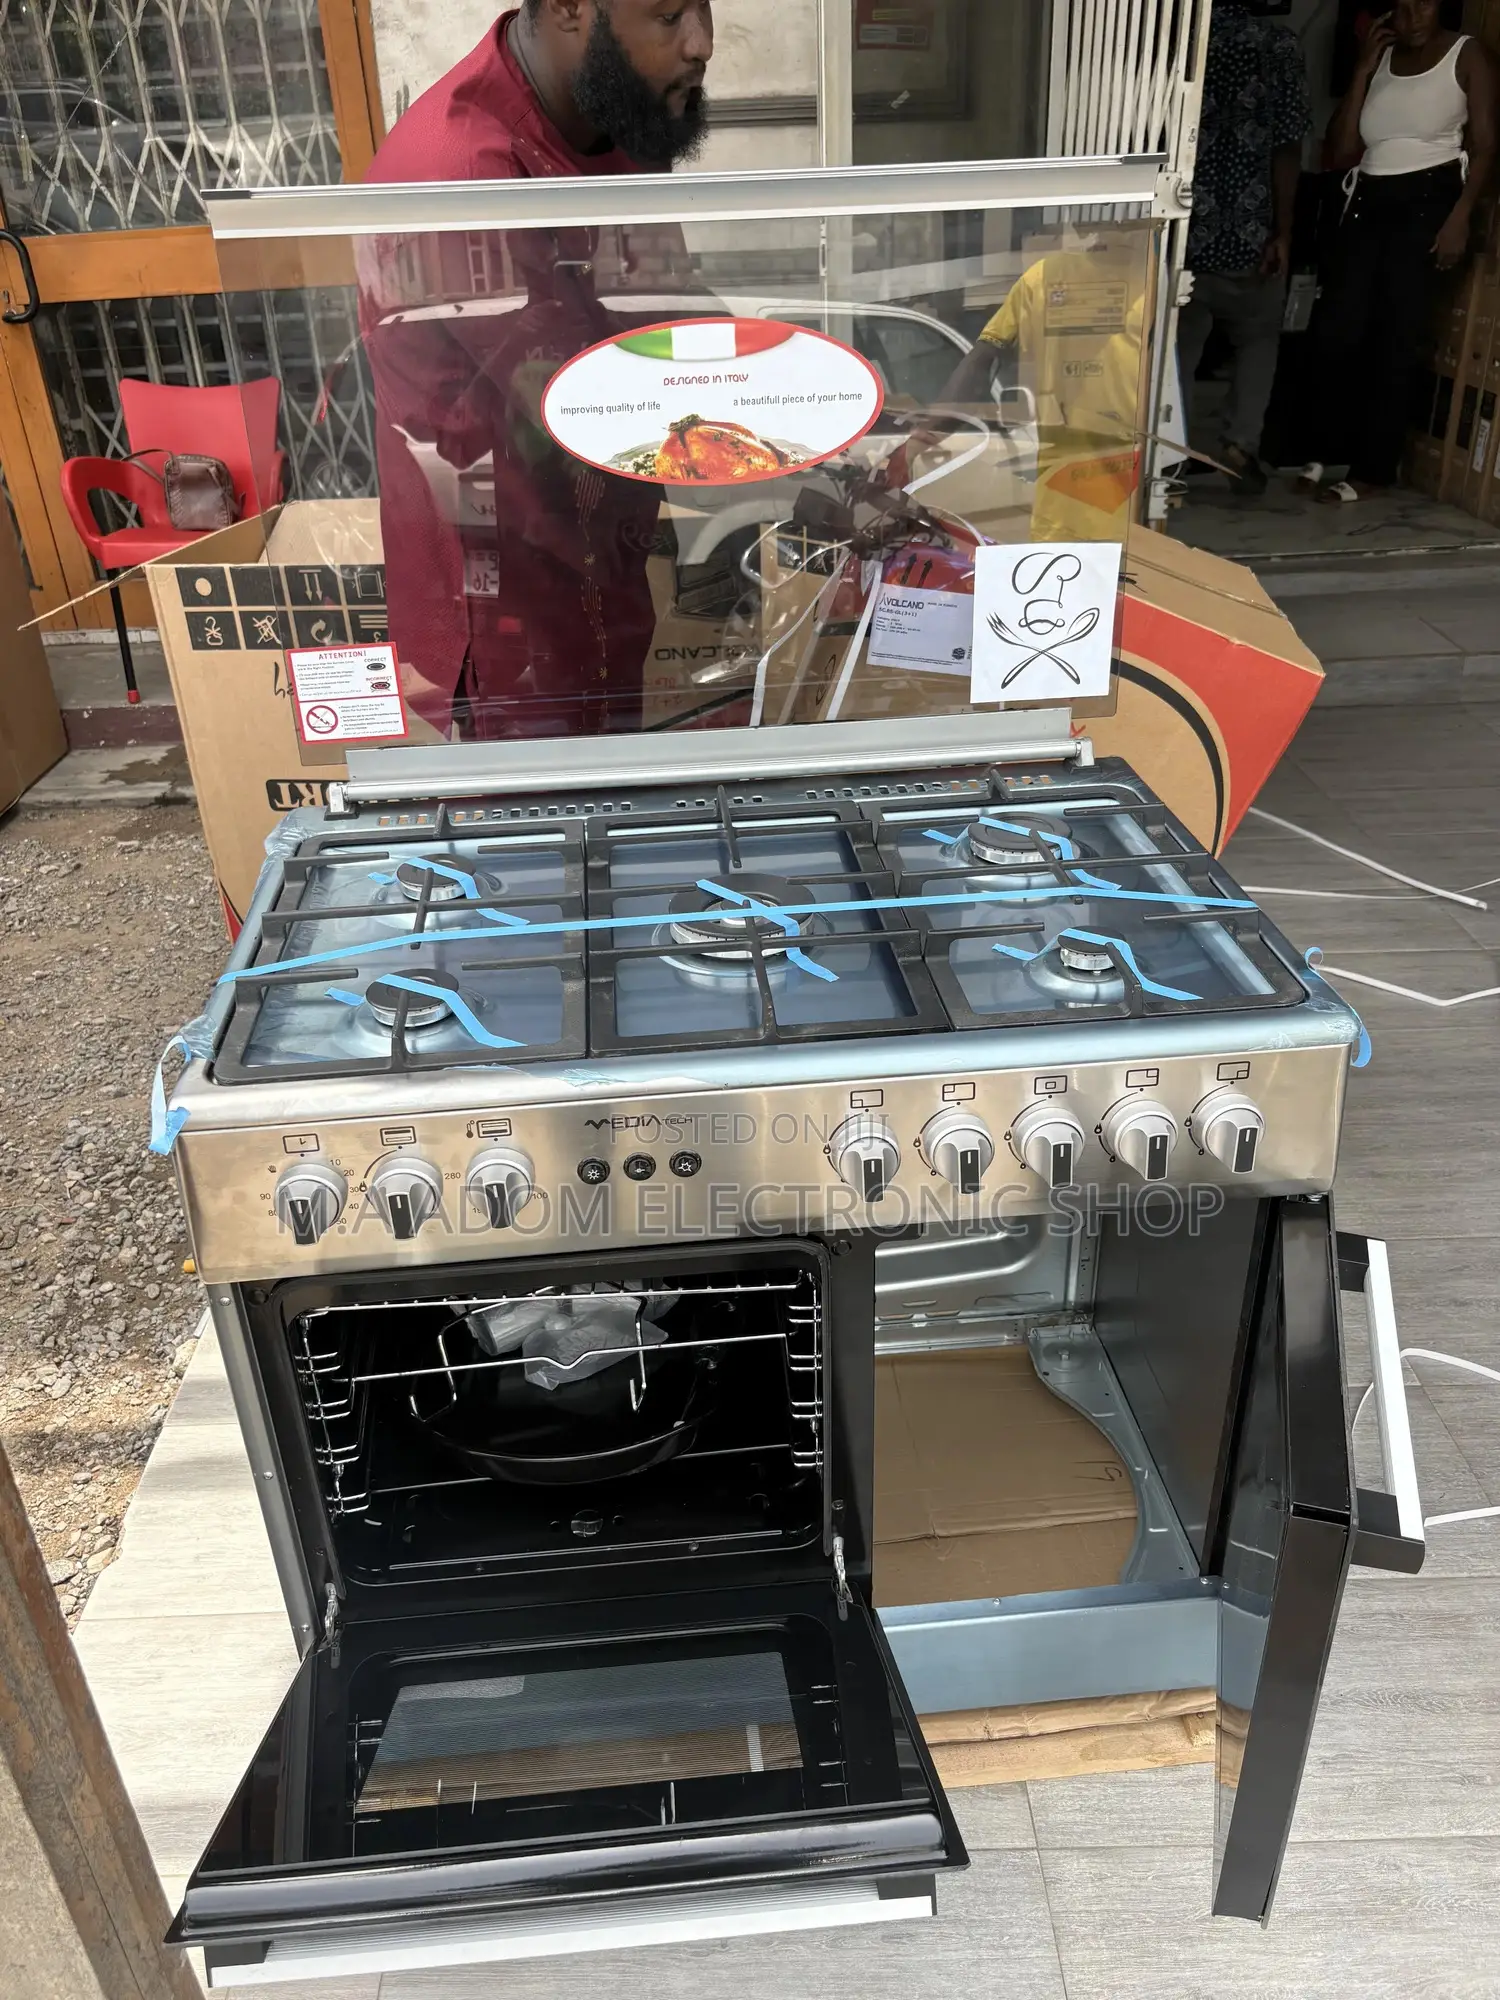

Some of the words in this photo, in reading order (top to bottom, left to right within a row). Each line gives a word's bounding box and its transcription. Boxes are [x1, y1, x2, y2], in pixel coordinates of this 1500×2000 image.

[663, 375, 710, 386] DESIGNED
[712, 374, 722, 385] IN
[724, 373, 749, 384] ITALY
[733, 399, 739, 407] a
[740, 394, 780, 406] beautifull
[782, 394, 805, 406] piece
[807, 393, 816, 404] of
[817, 394, 837, 405] your
[838, 391, 863, 402] home
[560, 404, 604, 416] improving
[605, 402, 635, 414] quality
[637, 401, 646, 412] of
[647, 400, 661, 412] life
[887, 597, 925, 610] VOLCANO
[318, 650, 367, 660] ATTENTION!
[330, 1158, 342, 1167] 10
[343, 1168, 355, 1177] 20
[444, 1171, 462, 1180] 280
[349, 1186, 360, 1194] 30
[259, 1192, 271, 1201] 90
[348, 1202, 360, 1210] 40
